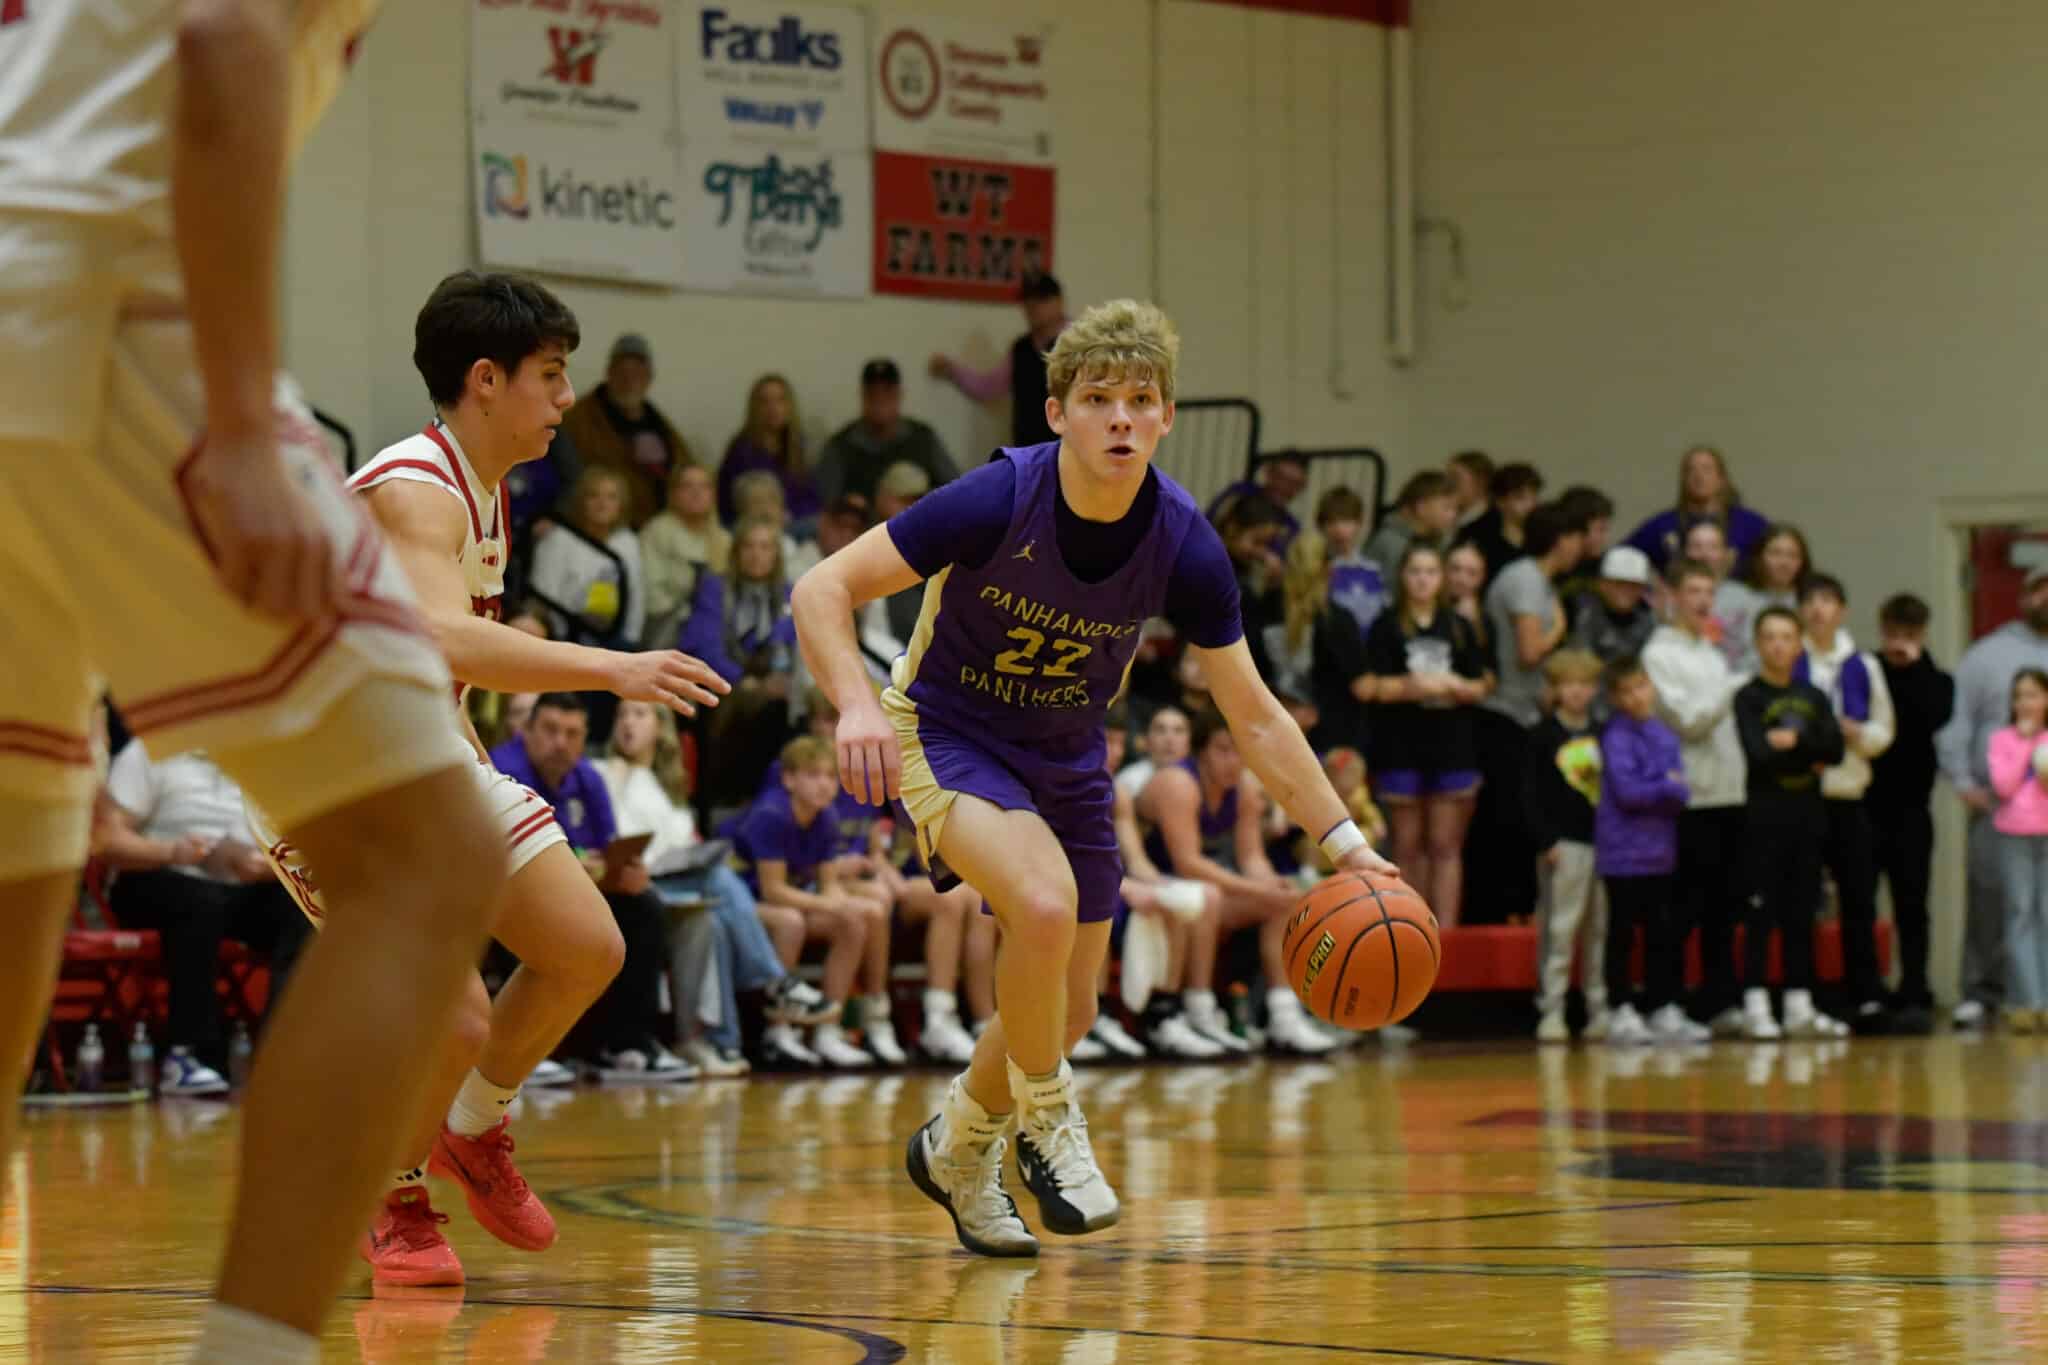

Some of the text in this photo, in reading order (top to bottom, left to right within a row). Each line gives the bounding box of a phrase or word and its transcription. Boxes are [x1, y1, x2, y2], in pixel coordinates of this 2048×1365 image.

[701, 8, 842, 70] Faulks
[540, 163, 675, 229] kinetic
[930, 168, 1012, 222] WT
[887, 225, 1043, 283] FARMS
[993, 626, 1093, 678] 22
